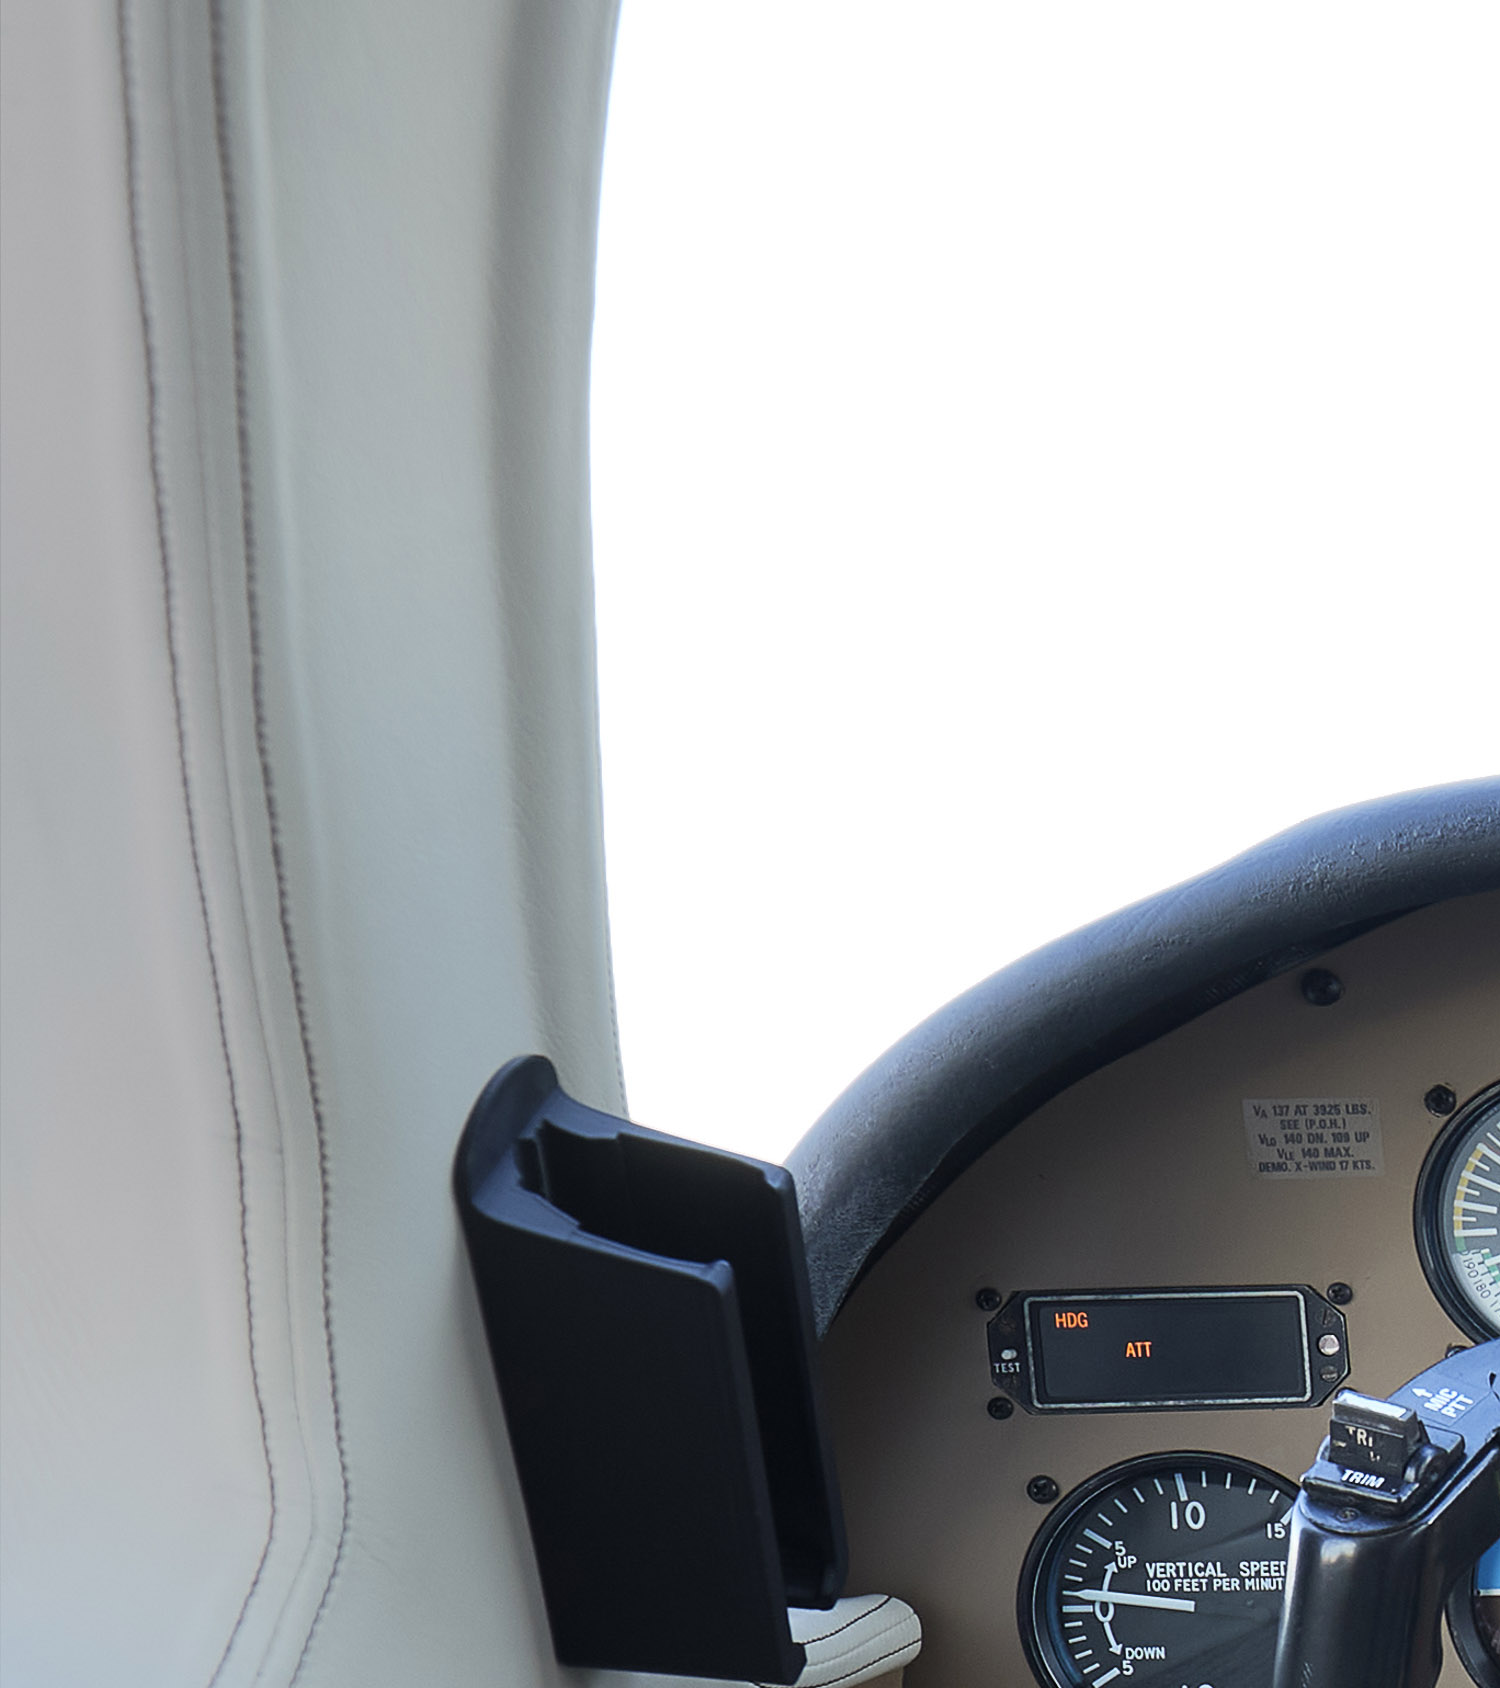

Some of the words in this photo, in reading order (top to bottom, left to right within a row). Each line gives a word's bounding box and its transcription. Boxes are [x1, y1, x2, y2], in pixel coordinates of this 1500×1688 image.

[1055, 1311, 1089, 1328] HDG
[1126, 1341, 1151, 1358] ATT
[994, 1362, 1020, 1373] TEST
[1117, 1555, 1137, 1569] UP
[1145, 1561, 1226, 1578] VERTICAL
[1125, 1646, 1165, 1660] DOWN
